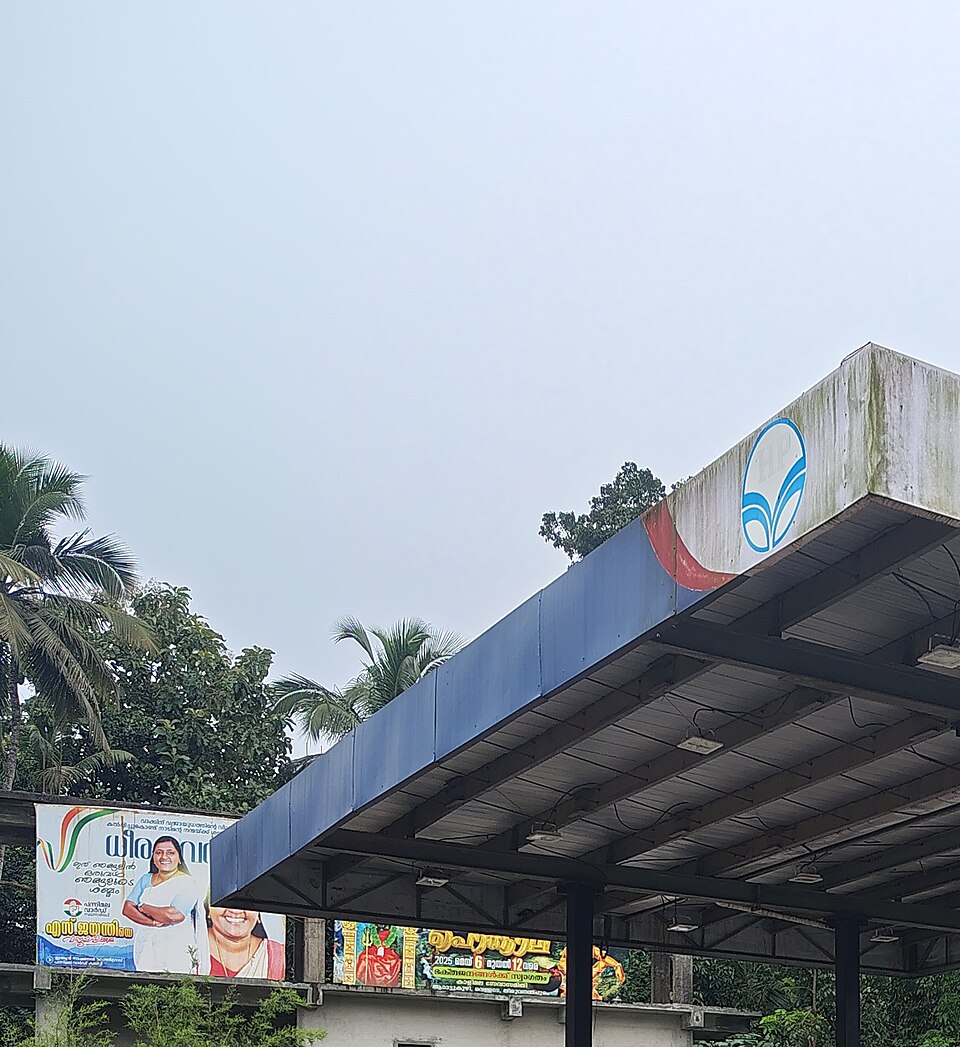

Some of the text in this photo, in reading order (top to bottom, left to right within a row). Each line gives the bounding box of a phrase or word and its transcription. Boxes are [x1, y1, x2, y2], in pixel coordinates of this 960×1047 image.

[434, 955, 453, 965] 2025
[474, 955, 483, 969] 6
[512, 957, 523, 971] 12
